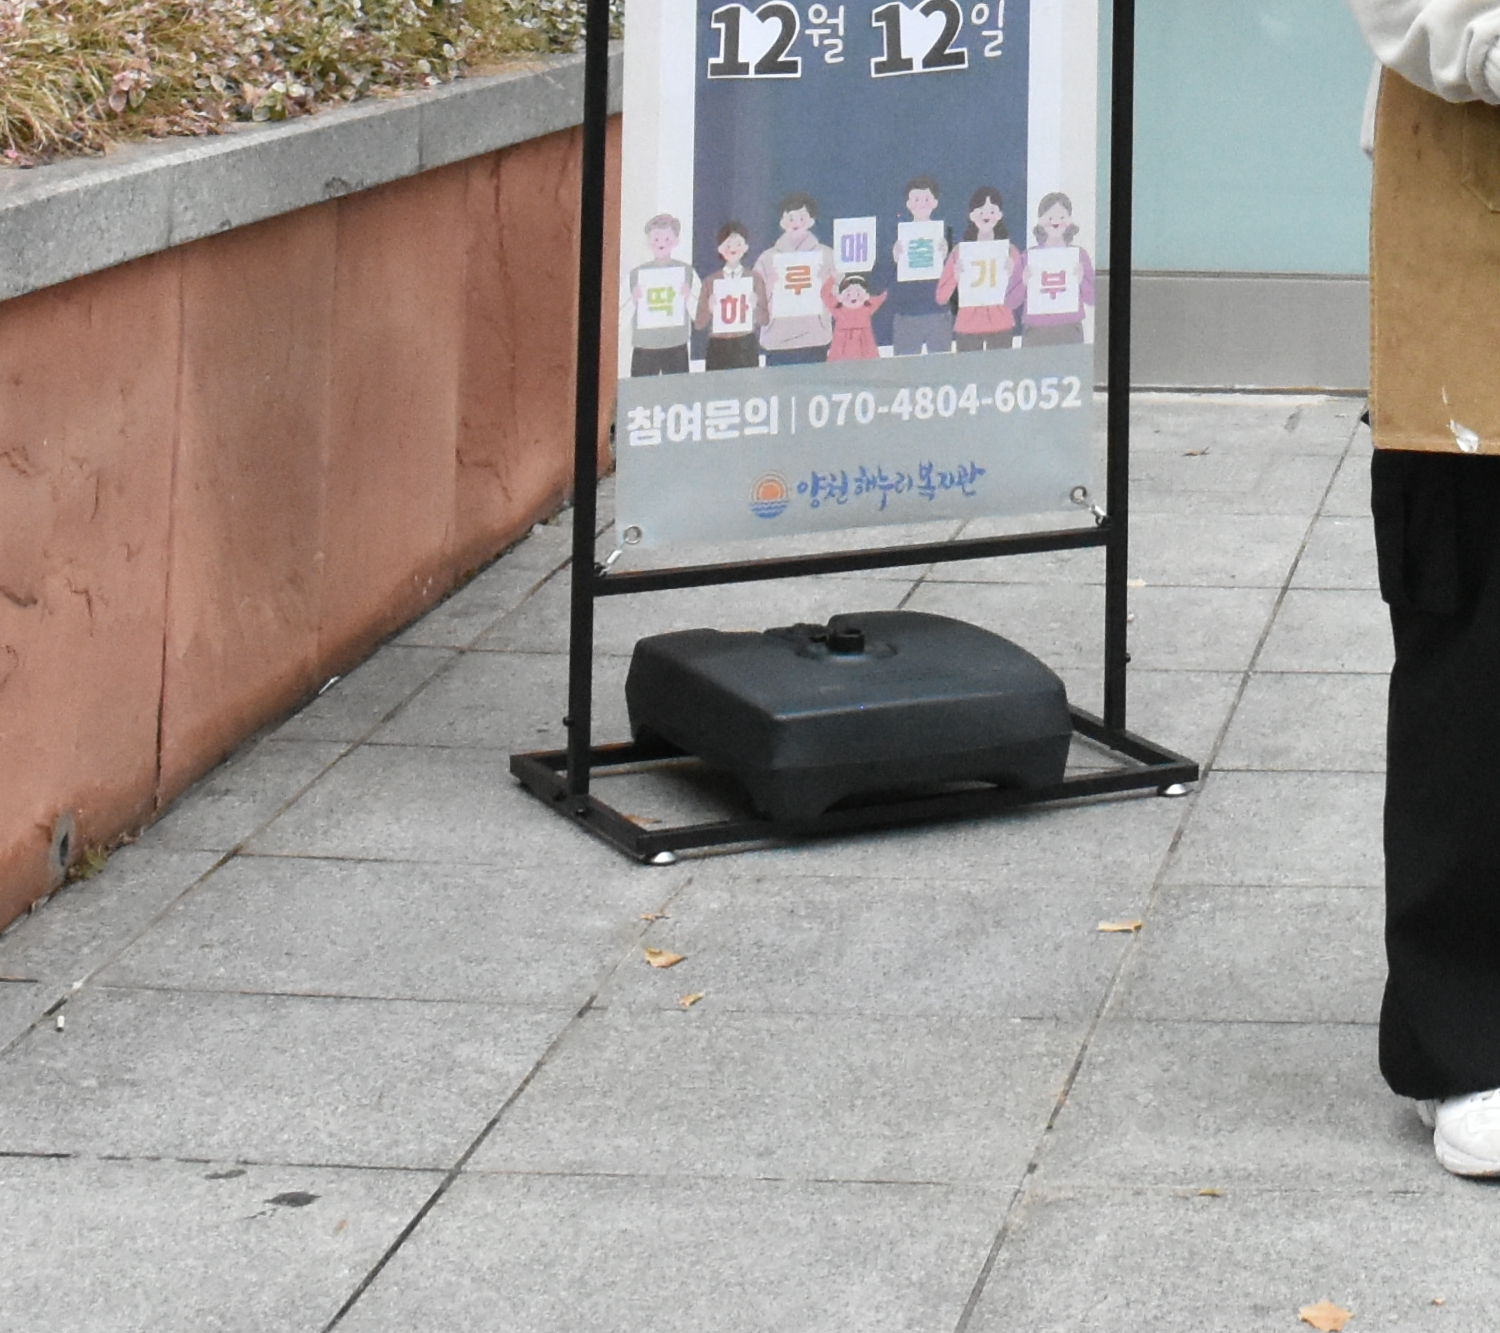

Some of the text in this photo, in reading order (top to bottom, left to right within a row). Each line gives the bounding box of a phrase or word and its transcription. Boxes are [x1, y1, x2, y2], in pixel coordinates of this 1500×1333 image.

[646, 230, 1068, 327] 딱 하 루 매 출 기 부
[626, 376, 1083, 447] 참여문의 070-4804-6052
